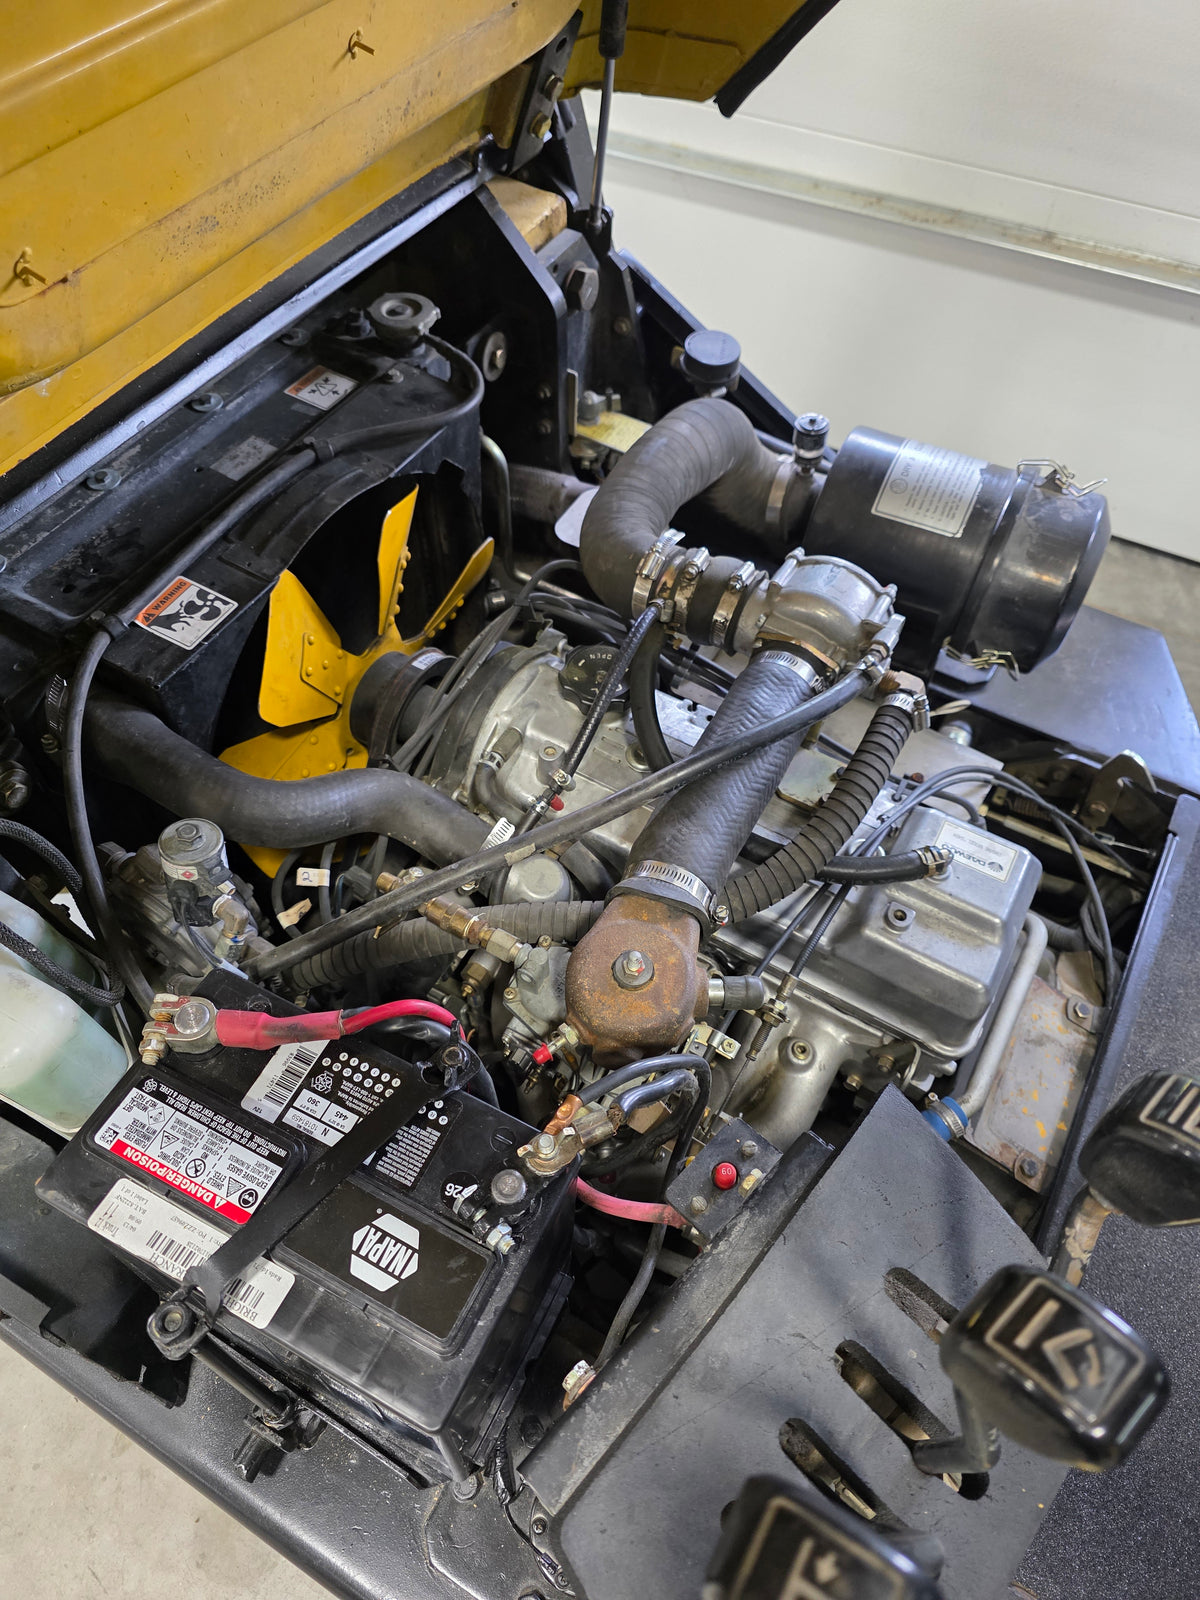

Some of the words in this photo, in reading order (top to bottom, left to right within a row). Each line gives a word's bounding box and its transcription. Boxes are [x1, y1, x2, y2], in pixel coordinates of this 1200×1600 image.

[151, 581, 187, 611] WARNING
[302, 871, 312, 882] 2
[157, 1082, 173, 1095] LEVEL.
[133, 1091, 146, 1102] FAST.
[165, 1095, 175, 1105] ALL
[176, 1093, 190, 1105] TIGHT
[306, 1096, 320, 1107] 360
[122, 1102, 133, 1112] GET
[128, 1097, 148, 1112] MEDICAL
[144, 1097, 158, 1108] HELP
[173, 1100, 187, 1111] READ
[189, 1100, 203, 1112] CAPS
[201, 1106, 215, 1117] VENT
[252, 1105, 262, 1113] 12V
[186, 1108, 211, 1124] CHILDREN.
[213, 1112, 226, 1124] KEEP
[334, 1110, 348, 1122] 445
[130, 1117, 146, 1130] WATER.
[169, 1123, 177, 1131] OR
[209, 1120, 217, 1128] OF
[225, 1119, 234, 1128] TIP.
[291, 1113, 318, 1131] 10181459
[124, 1123, 152, 1142] IMMEDIATELY
[145, 1125, 157, 1136] WITH
[176, 1127, 198, 1142] BLINDNESS
[186, 1124, 203, 1137] SEVERE
[215, 1123, 232, 1136] REACH
[232, 1124, 244, 1134] NOT
[242, 1129, 251, 1138] DO
[320, 1127, 329, 1137] N
[122, 1131, 135, 1142] EYES
[230, 1131, 241, 1141] THE
[133, 1137, 147, 1149] FLUSH
[180, 1137, 194, 1148] CAUSE
[246, 1140, 257, 1149] OUT
[252, 1134, 286, 1157] INSTRUCTIONS.
[172, 1149, 185, 1160] ACID
[180, 1145, 190, 1154] CAN
[200, 1151, 208, 1159] NO
[255, 1145, 269, 1156] KEEP
[157, 1150, 181, 1167] SULFURIC
[228, 1154, 251, 1170] BLINDNESS
[122, 1145, 213, 1202] DANGER/POISON
[226, 1162, 243, 1176] GASES
[249, 1166, 264, 1177] CAUSE
[269, 1168, 276, 1176] OR
[211, 1170, 226, 1182] EYES.
[241, 1171, 267, 1189] EXPLOSIVE
[262, 1173, 272, 1182] CAN
[206, 1176, 224, 1190] SHIELD
[123, 1187, 131, 1195] of
[443, 1182, 463, 1198] 26
[133, 1193, 148, 1204] Label
[94, 1216, 103, 1228] 12
[100, 1220, 119, 1237] Truck
[359, 1228, 412, 1275] NAPA
[148, 1252, 185, 1278] RANCH
